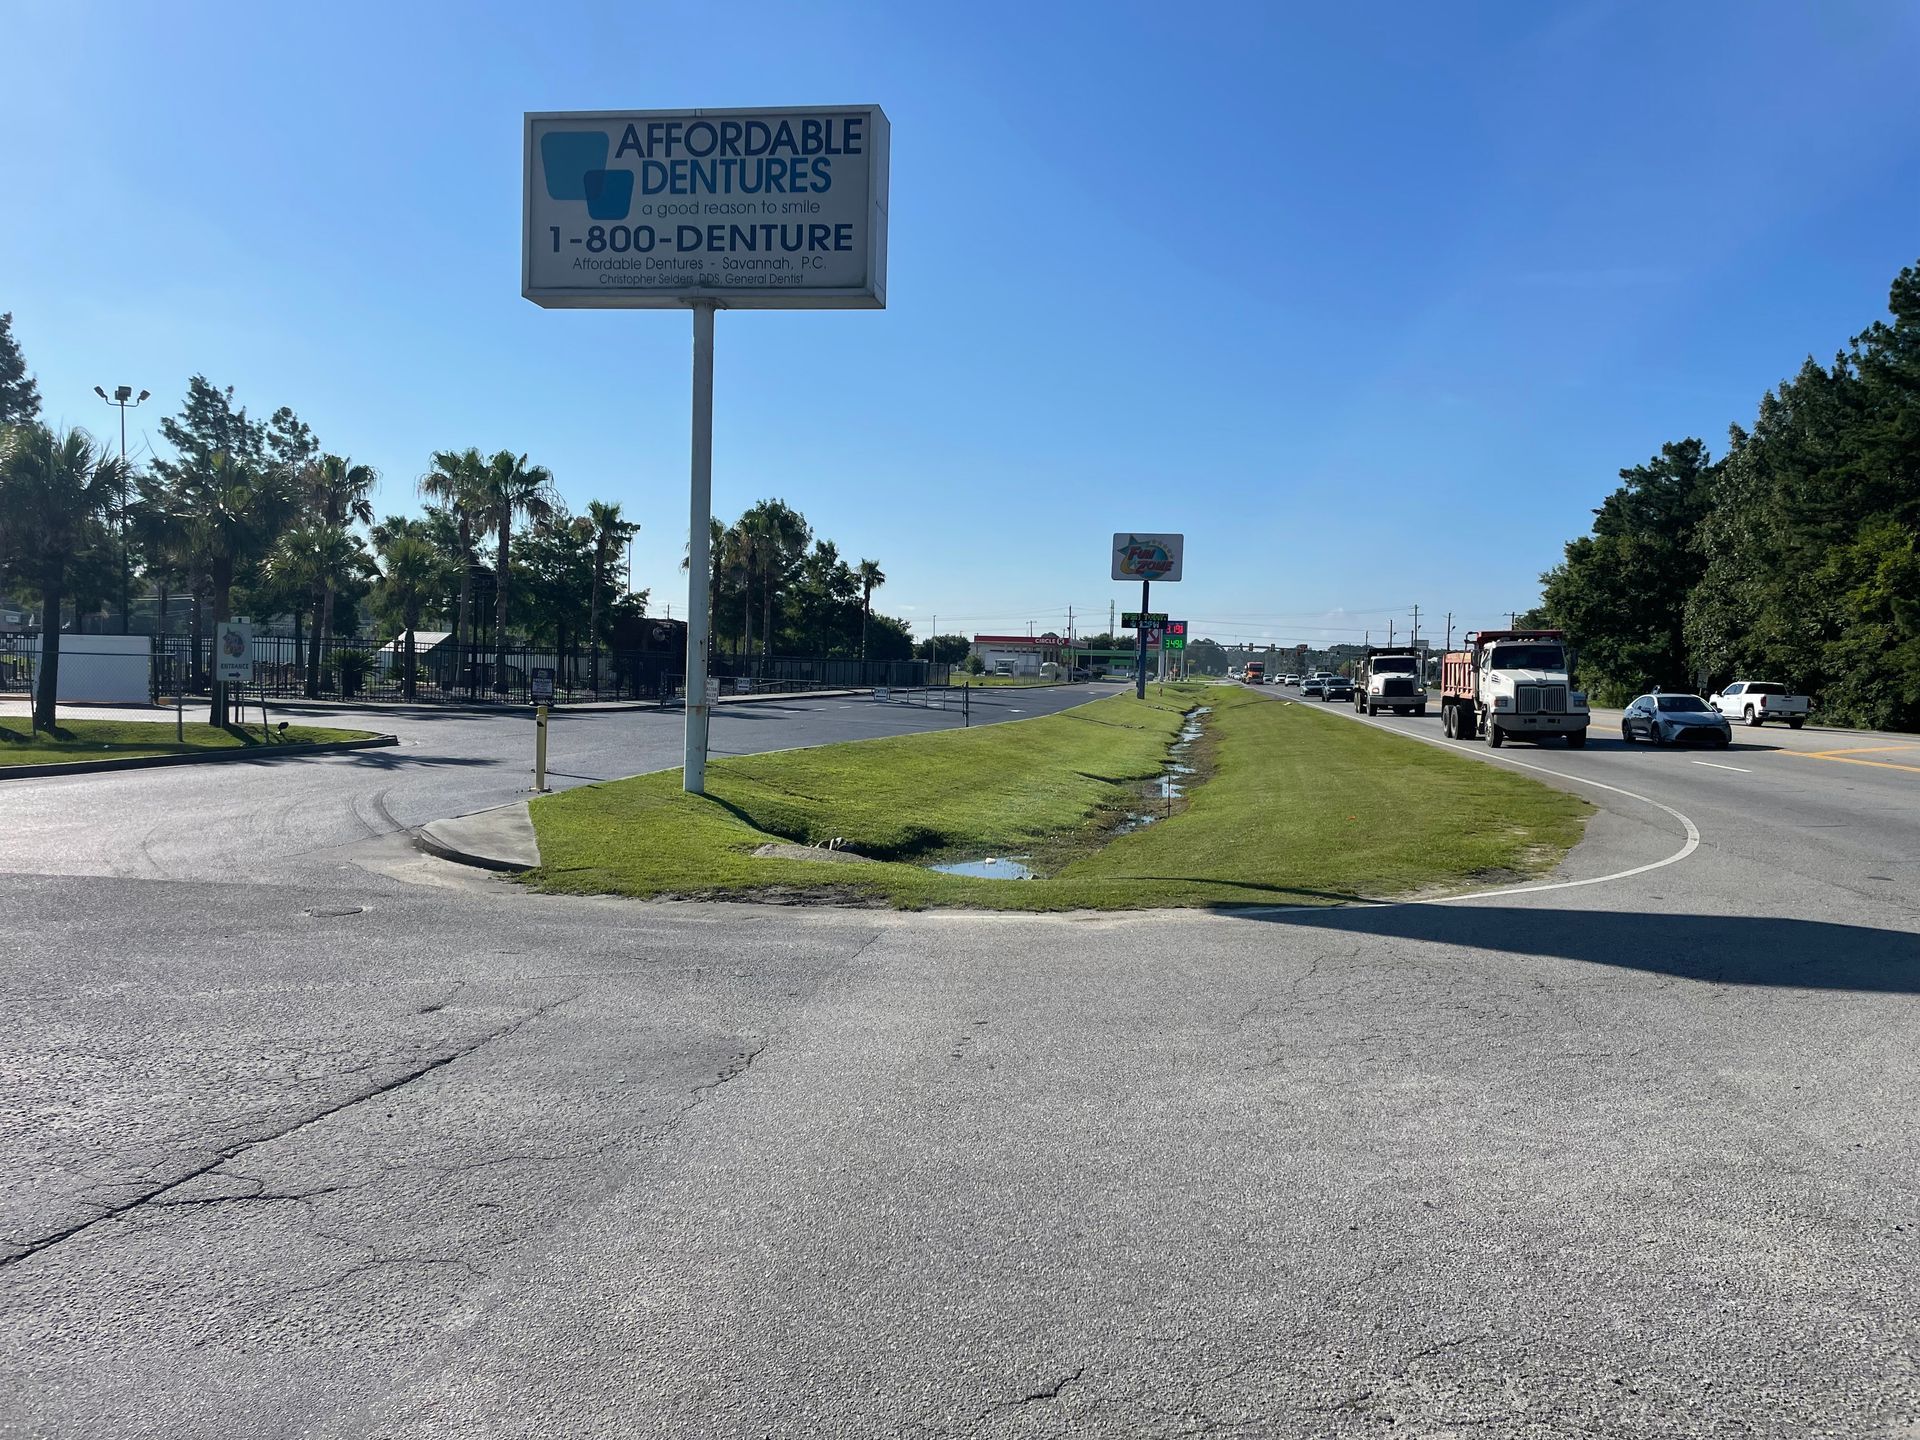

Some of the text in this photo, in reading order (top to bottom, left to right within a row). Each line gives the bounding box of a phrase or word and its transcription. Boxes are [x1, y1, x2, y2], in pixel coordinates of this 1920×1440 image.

[614, 118, 863, 159] AFFORDABLE
[641, 156, 832, 195] DENTURES
[642, 200, 821, 218] a good reason to smile
[549, 223, 853, 253] 1-800-DENTURE
[573, 257, 642, 270] Affordable
[646, 257, 704, 270] Dentures
[722, 256, 794, 271] Savannah,
[599, 273, 656, 286] Christopher
[725, 273, 767, 284] General
[769, 273, 804, 284] Dentist
